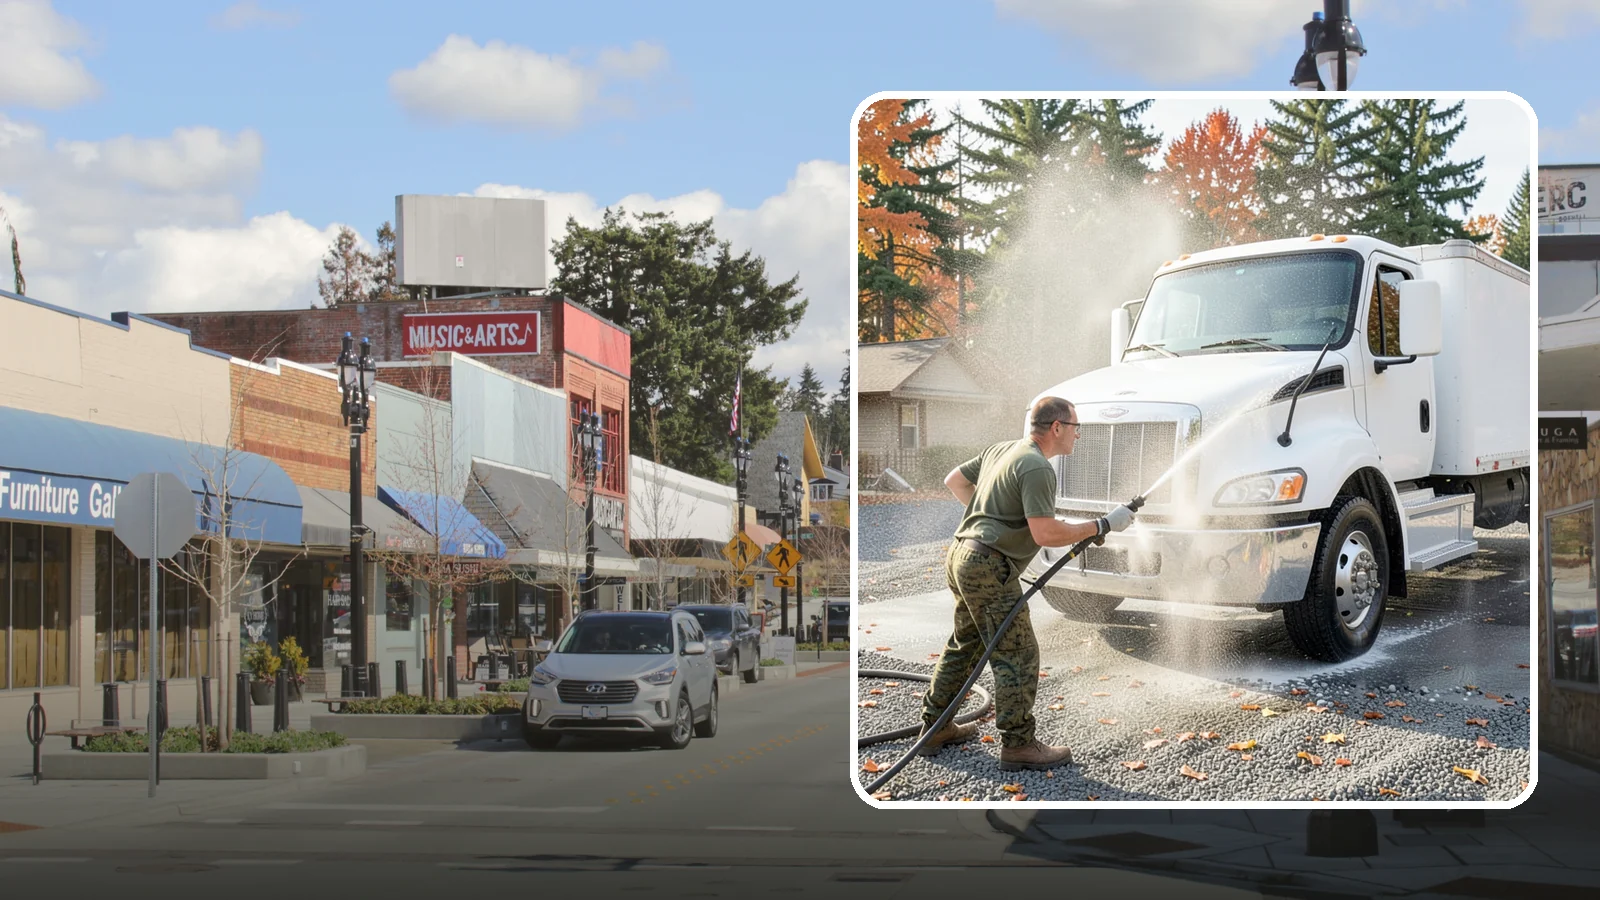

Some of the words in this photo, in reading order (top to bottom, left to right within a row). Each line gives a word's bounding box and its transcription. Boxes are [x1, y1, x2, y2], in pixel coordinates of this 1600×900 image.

[409, 323, 519, 348] MUSIC&ARTS
[1541, 428, 1577, 436] UGA
[0, 471, 79, 515] Furniture
[89, 482, 121, 518] Gal
[453, 563, 479, 574] SUSHI
